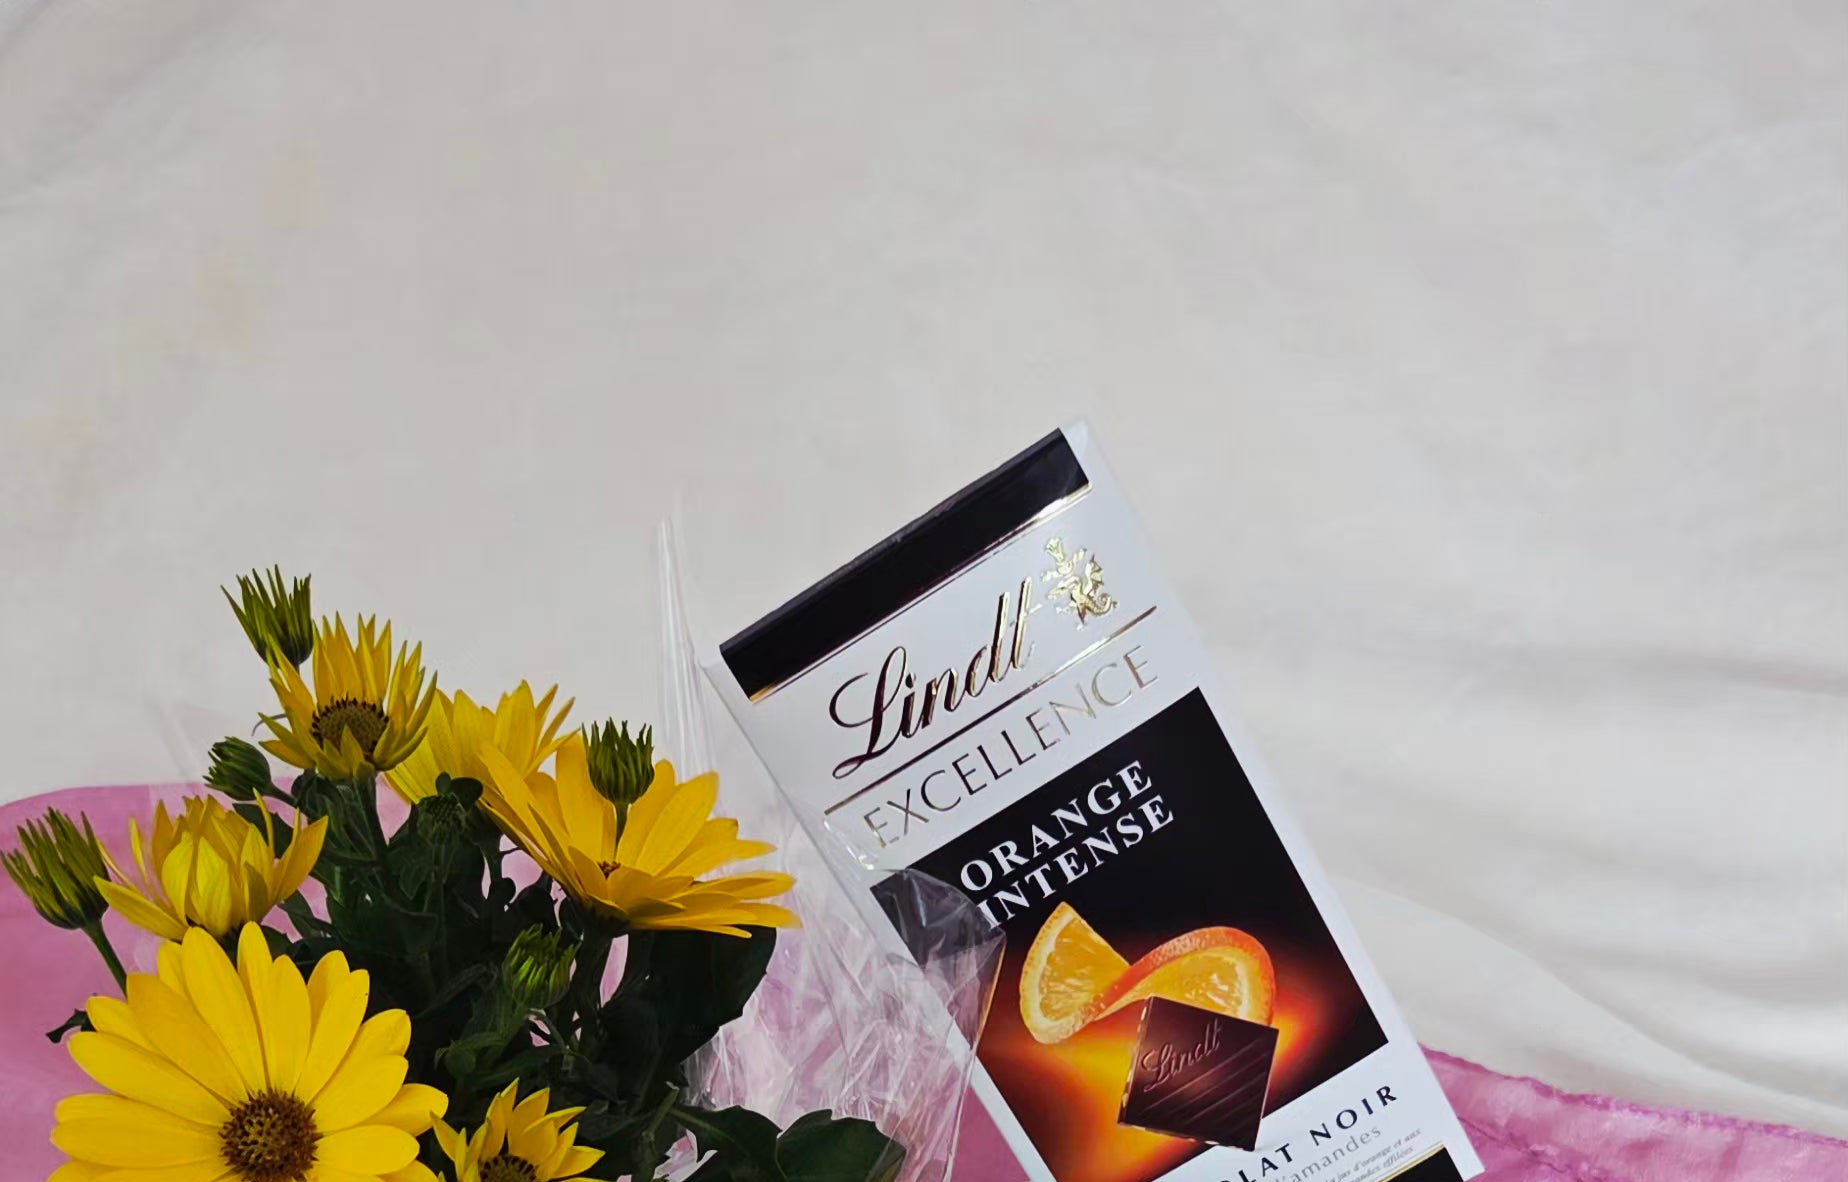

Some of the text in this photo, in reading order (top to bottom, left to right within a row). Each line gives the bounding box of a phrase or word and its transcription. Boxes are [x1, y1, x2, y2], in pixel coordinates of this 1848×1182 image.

[829, 576, 1041, 779] Lindt
[862, 645, 1159, 849] EXCELLENCE
[961, 760, 1152, 891] ORANGE
[977, 795, 1174, 932] INTENSE
[1143, 1018, 1222, 1093] Lindt
[1309, 1086, 1397, 1146] NOIR
